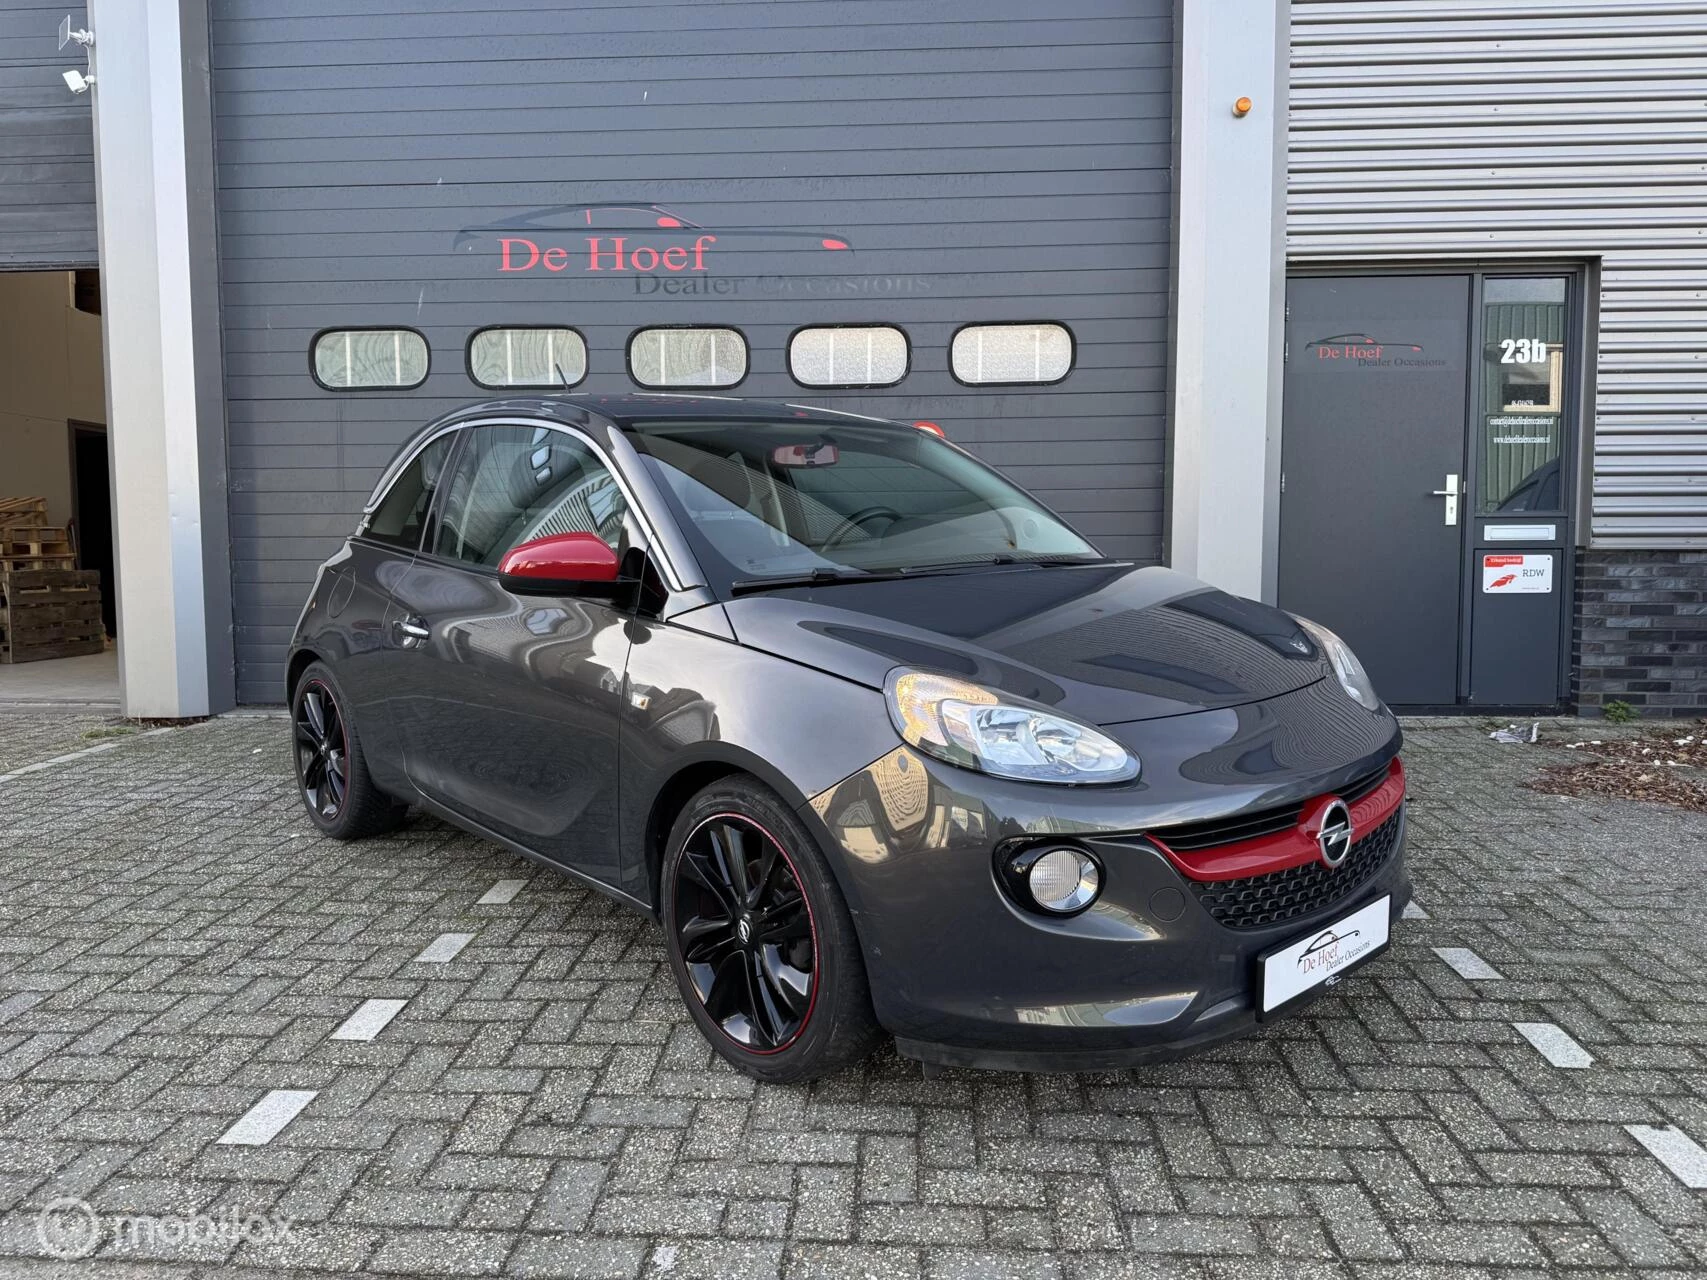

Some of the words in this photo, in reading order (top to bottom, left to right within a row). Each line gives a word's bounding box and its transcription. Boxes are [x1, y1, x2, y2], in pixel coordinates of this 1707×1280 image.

[497, 238, 568, 272] De
[584, 235, 717, 271] Hoef
[633, 272, 746, 295] Dealer
[757, 273, 932, 296] Occasions
[1318, 346, 1340, 359] De
[1345, 345, 1384, 359] Hoef
[1358, 358, 1390, 367] Dealer
[1394, 358, 1447, 367] Occasions
[1500, 338, 1547, 364] 23b
[1522, 569, 1545, 577] RDW
[1303, 958, 1316, 974] De
[1318, 941, 1339, 966] Hoef
[1326, 954, 1344, 972] Dealer
[1345, 941, 1370, 961] Occasions
